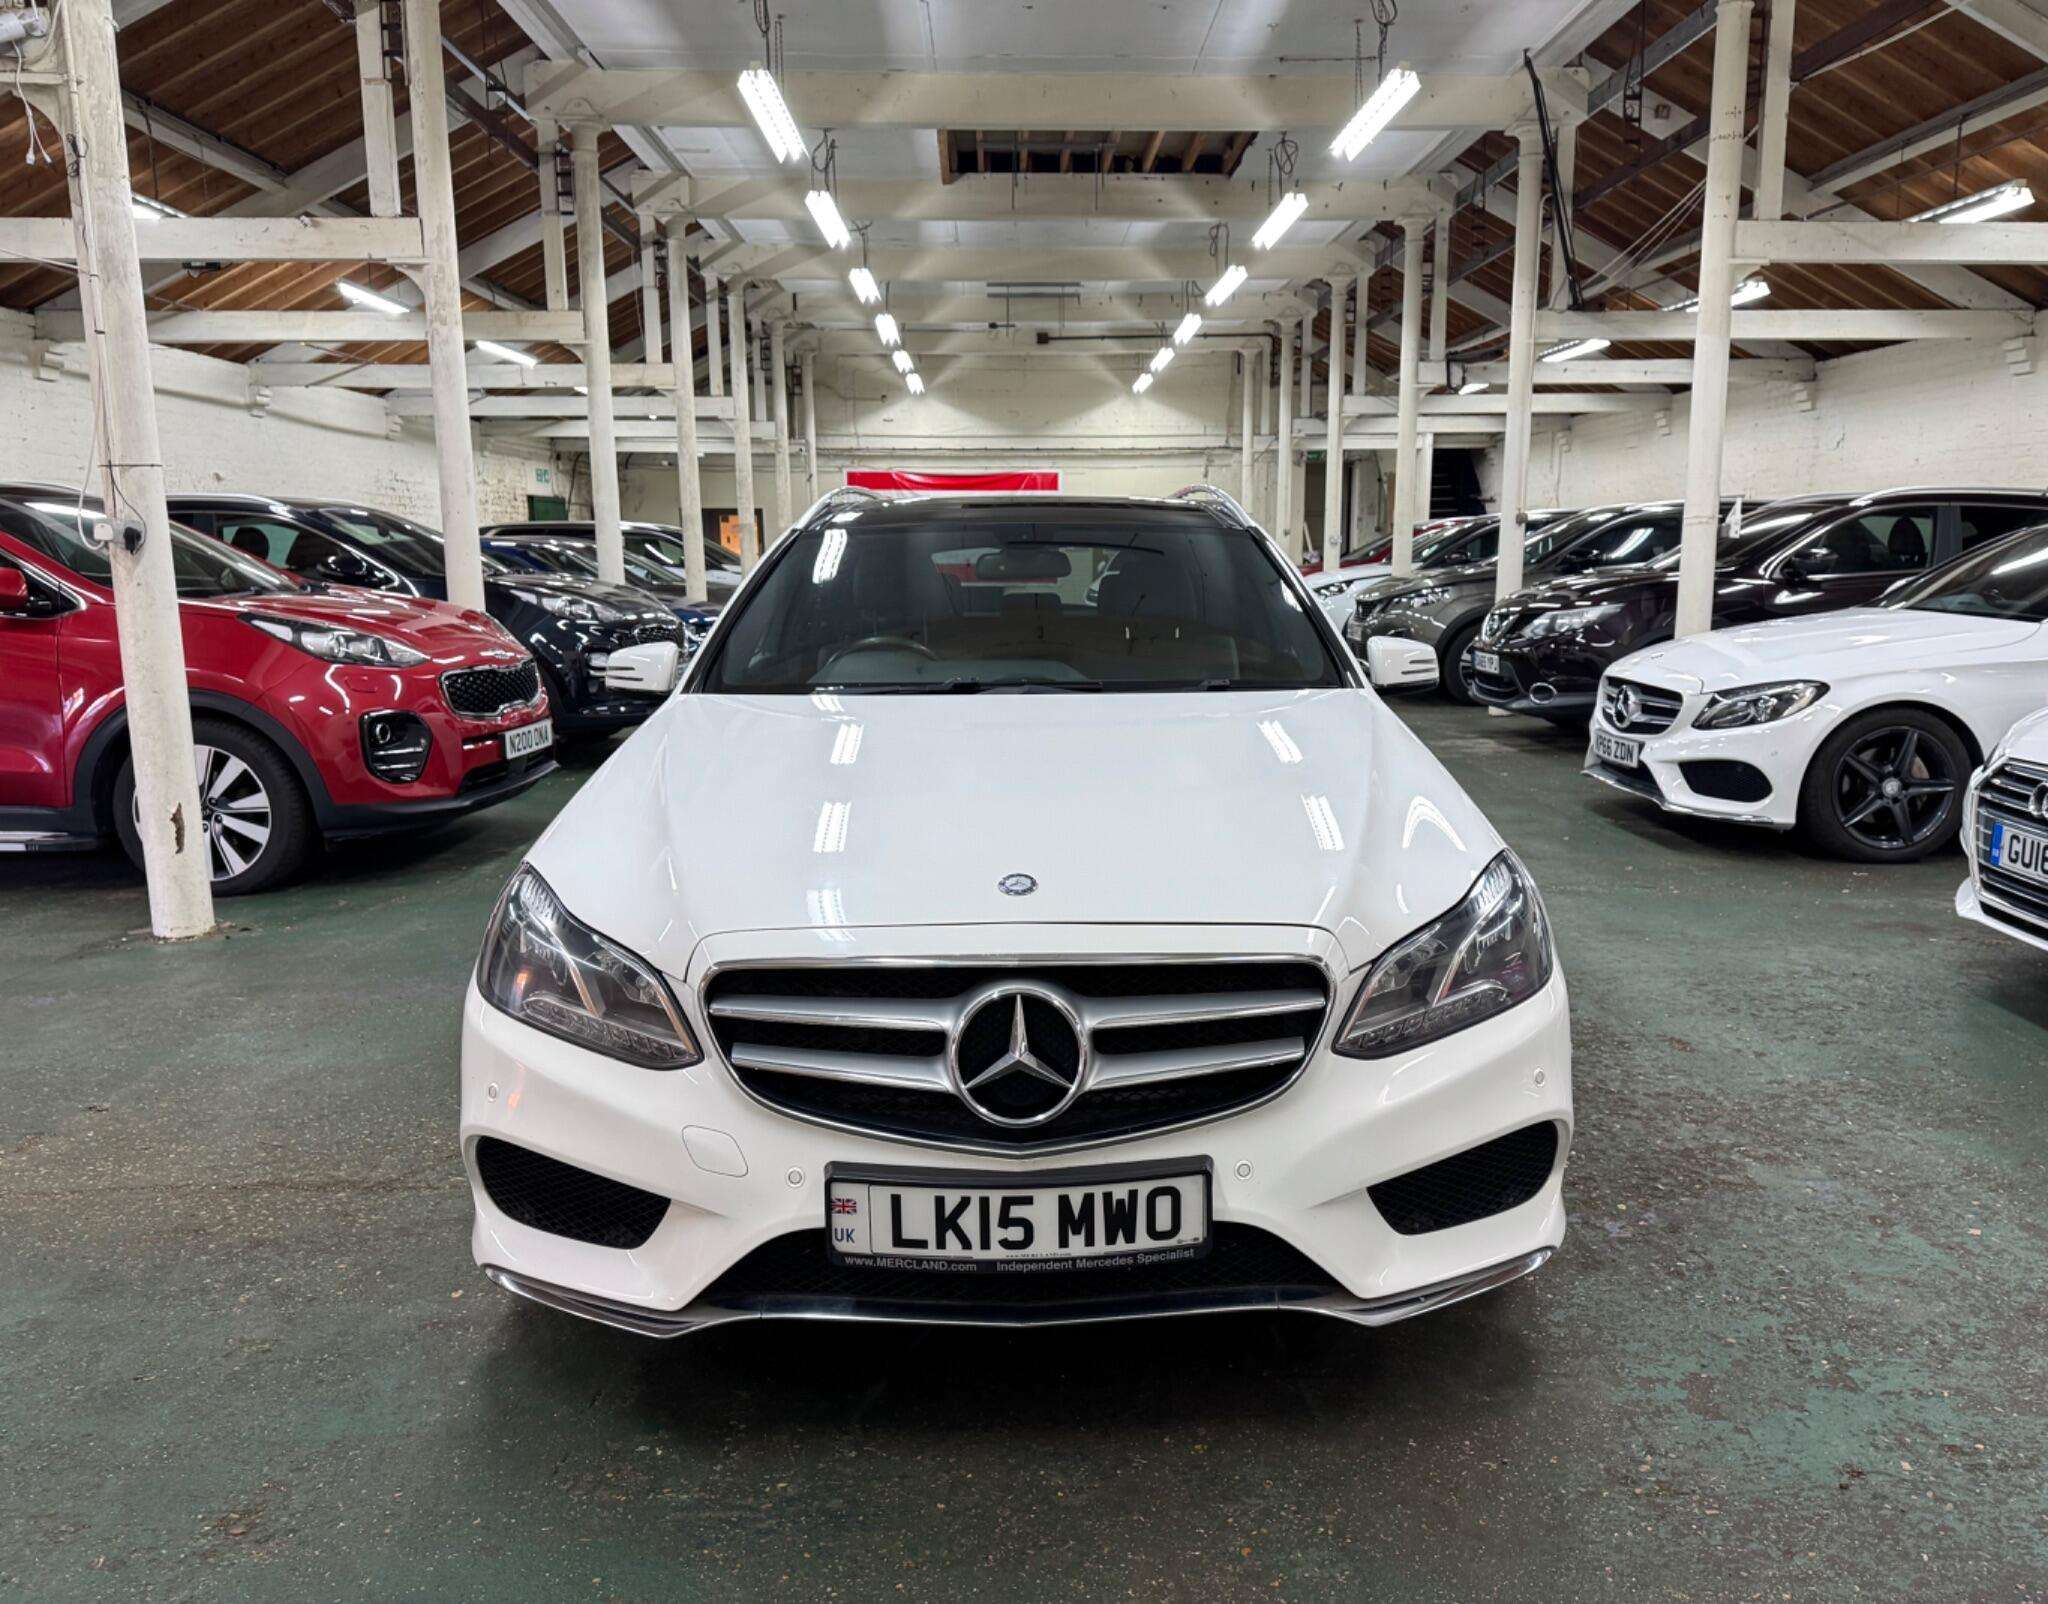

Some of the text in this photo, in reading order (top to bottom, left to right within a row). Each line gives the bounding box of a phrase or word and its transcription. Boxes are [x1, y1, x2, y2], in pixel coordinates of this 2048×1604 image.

[509, 730, 532, 754] N200
[1614, 741, 1634, 763] ZDN
[890, 1186, 1182, 1250] LK15 MWO
[834, 1228, 855, 1243] UK
[844, 1248, 1195, 1273] www.MERCLAND.com Independent Mercedes Specialist
